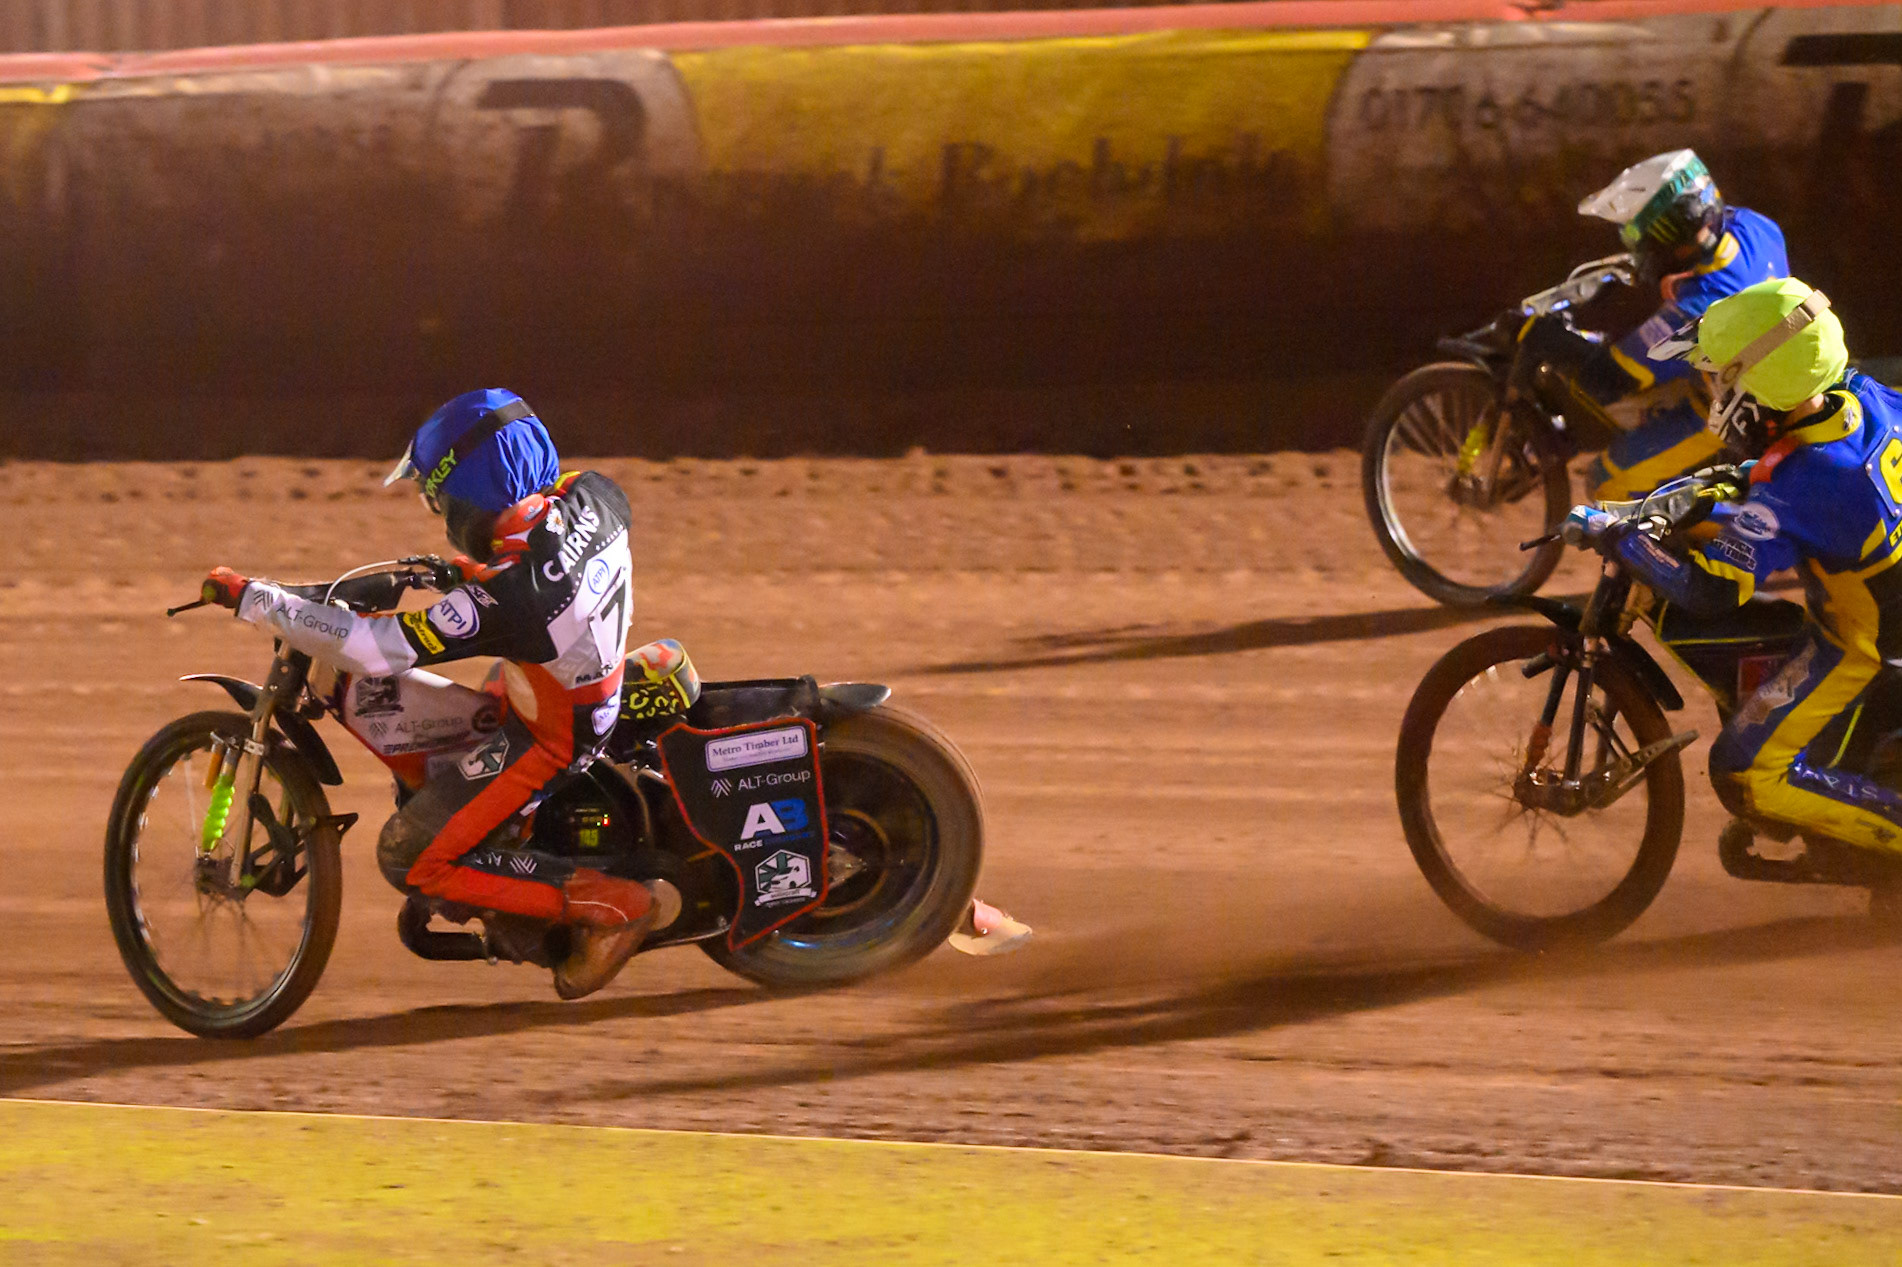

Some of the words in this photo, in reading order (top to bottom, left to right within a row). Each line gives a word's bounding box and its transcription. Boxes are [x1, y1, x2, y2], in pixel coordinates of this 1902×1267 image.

[543, 505, 600, 582] CAIRNS
[592, 566, 605, 588] ATPI
[276, 606, 350, 641] ALT-Group
[441, 599, 467, 630] ATPI
[600, 578, 626, 653] 7
[712, 744, 742, 757] Metro
[744, 738, 779, 752] Timber
[782, 733, 799, 745] Ltd
[738, 769, 811, 791] ALT-Group
[734, 840, 763, 852] RACE
